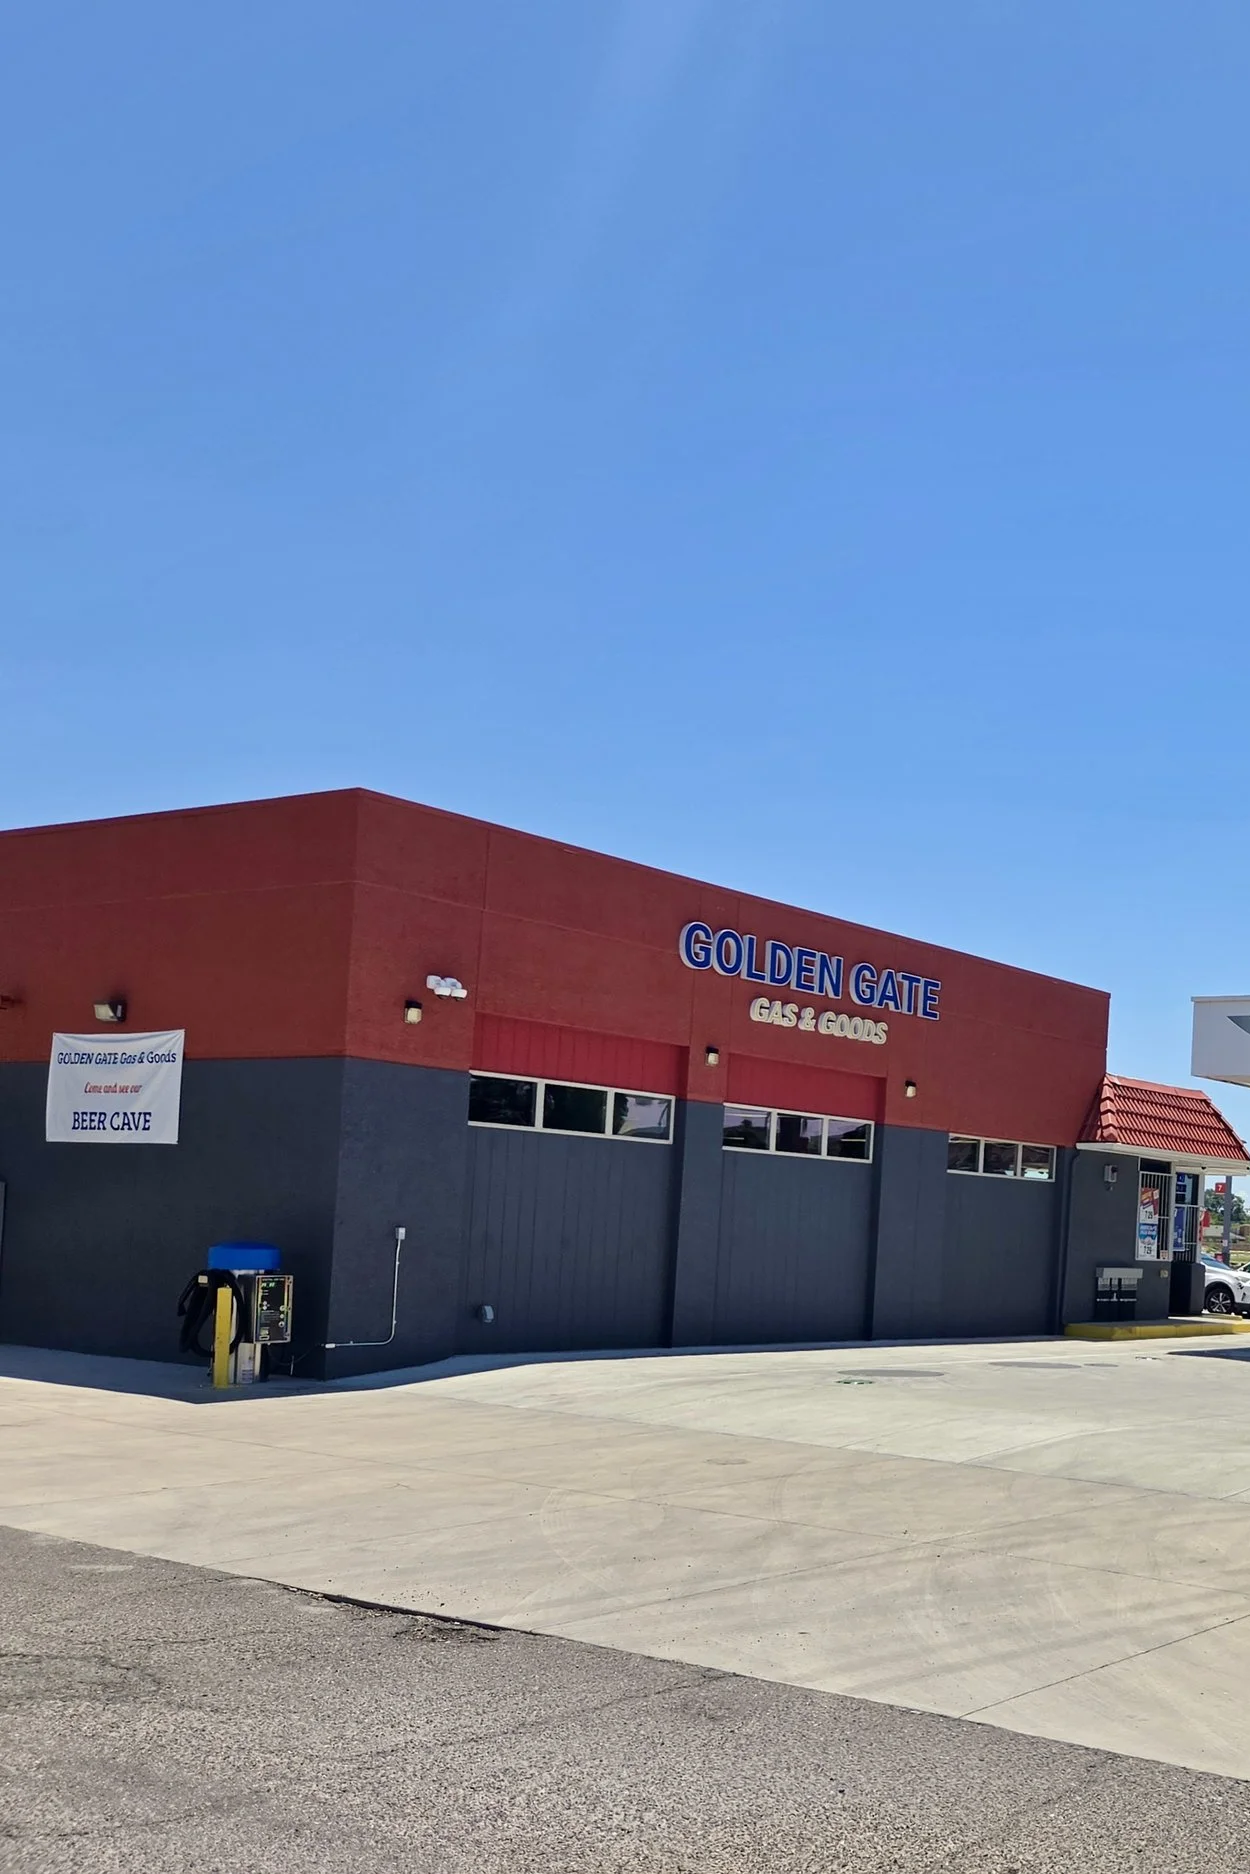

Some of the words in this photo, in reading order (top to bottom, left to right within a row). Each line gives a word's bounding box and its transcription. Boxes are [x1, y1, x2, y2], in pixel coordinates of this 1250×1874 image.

[679, 921, 844, 1000] GOLDEN
[849, 962, 942, 1021] GATE
[750, 997, 799, 1027] GAS
[798, 1007, 816, 1032] &
[818, 1011, 888, 1045] GOODS
[57, 1052, 94, 1065] GOLDEN
[95, 1052, 119, 1065] GATE
[119, 1052, 137, 1065] Gas
[138, 1052, 145, 1064] &
[146, 1050, 177, 1064] Goods
[71, 1111, 107, 1131] BEER
[109, 1111, 152, 1131] CAVE
